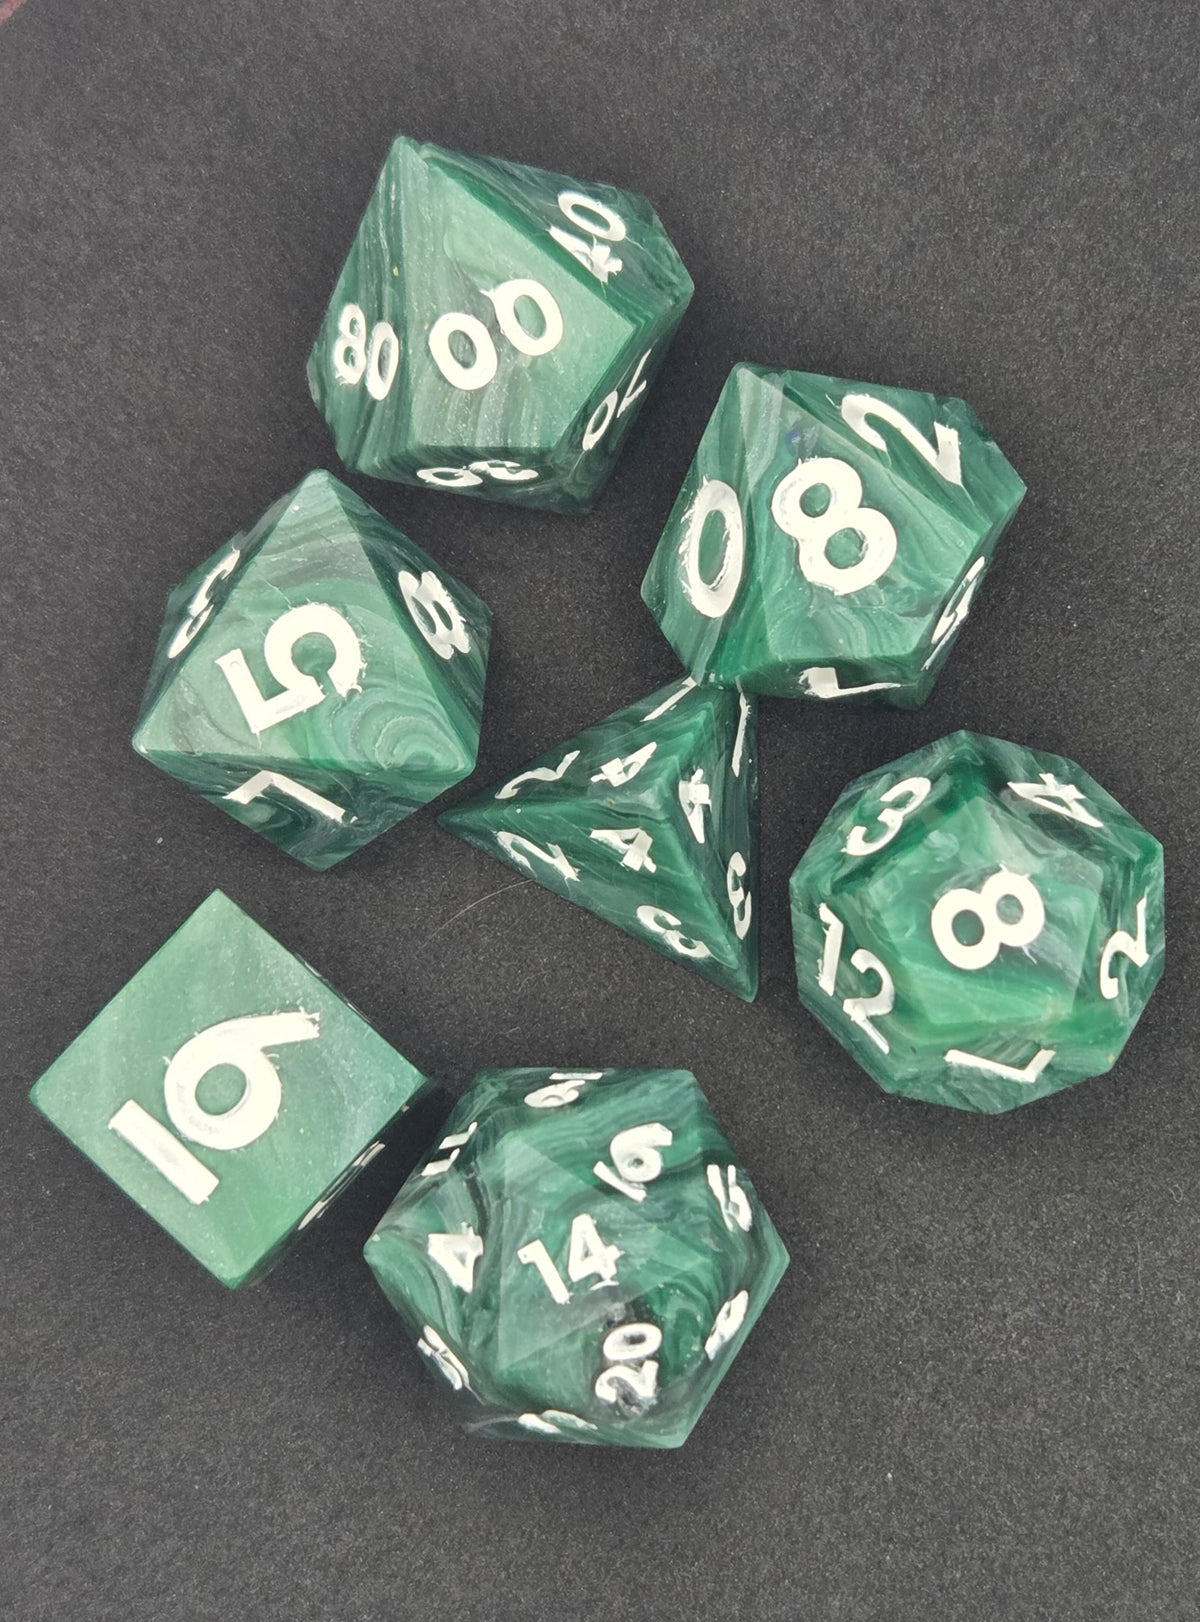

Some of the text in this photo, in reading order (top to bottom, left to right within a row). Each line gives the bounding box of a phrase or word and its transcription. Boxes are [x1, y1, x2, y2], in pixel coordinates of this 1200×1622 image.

[334, 303, 400, 401] 80
[428, 278, 564, 390] 00
[840, 393, 962, 486] 2
[680, 476, 744, 619] 0
[771, 456, 898, 597] 8
[398, 571, 472, 660] 8
[214, 601, 366, 734] 5
[841, 777, 932, 856] 3
[1007, 773, 1105, 828] 4
[636, 905, 713, 958] 3
[931, 870, 1046, 970] 8
[1100, 896, 1150, 999] 2
[815, 903, 895, 1054] 12
[593, 1122, 673, 1203] 6
[426, 1221, 483, 1294] 4
[517, 1214, 624, 1304] 14
[595, 1322, 662, 1403] 20
